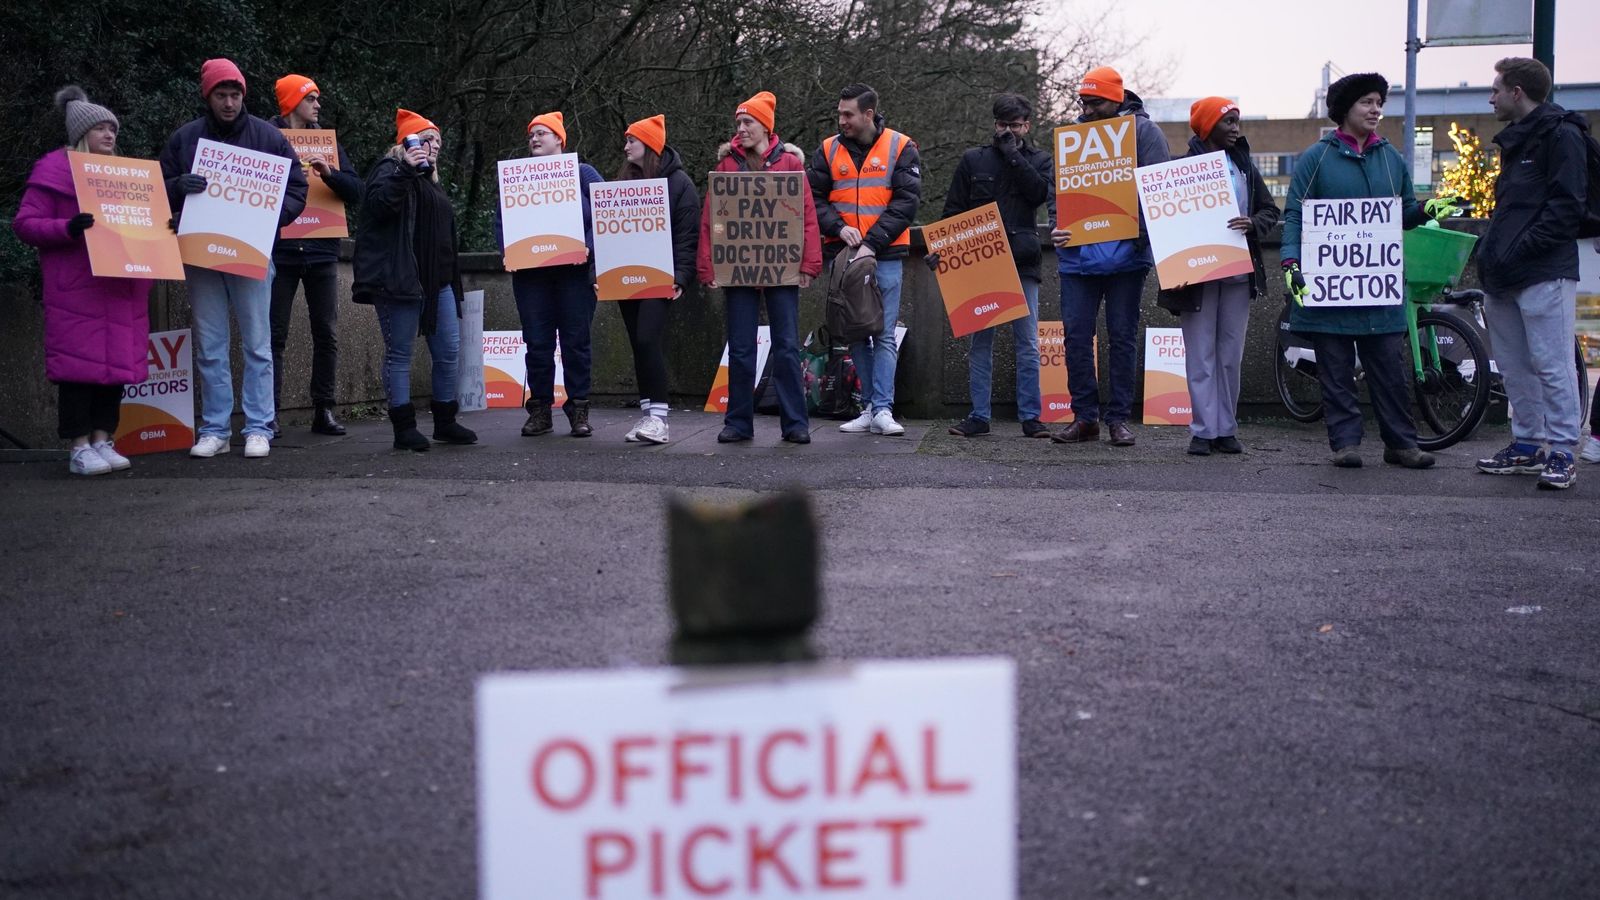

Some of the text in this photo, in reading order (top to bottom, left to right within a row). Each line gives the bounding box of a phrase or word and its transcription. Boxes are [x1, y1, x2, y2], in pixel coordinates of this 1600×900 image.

[286, 135, 332, 144] HOUR IS
[1058, 121, 1130, 166] PAY
[201, 147, 270, 171] £15/HOUR
[272, 163, 285, 174] IS
[503, 159, 574, 176] £15/HOUR IS
[1059, 156, 1132, 176] RESTORATION FOR
[83, 163, 150, 179] FIX OUR PAY
[198, 158, 282, 184] NOT A FAIR WAGE
[503, 175, 520, 184] NOT
[530, 172, 549, 181] FAIR
[551, 169, 574, 179] WAGE
[1059, 166, 1133, 191] DOCTORS
[1141, 158, 1223, 184] £15/HOUR IS
[87, 178, 154, 192] RETAIN OUR
[224, 175, 232, 185] A
[234, 176, 280, 195] JUNIOR
[504, 178, 576, 194] FOR A JUNIOR
[713, 176, 799, 196] CUTS TO
[1142, 170, 1225, 194] NOT A FAIR WAGE
[1145, 179, 1228, 204] FOR A JUNIOR
[96, 189, 150, 202] DOCTORS
[207, 182, 277, 211] OCTOR
[504, 188, 577, 208] DOCTOR
[594, 185, 664, 199] £15/HOUR IS
[101, 203, 151, 216] PROTECT
[594, 196, 664, 208] NOT A FAIR WAGE
[738, 198, 778, 218] PAY
[1147, 190, 1232, 221] DOCTOR
[103, 214, 153, 227] THE NHS
[302, 216, 320, 224] BMA
[595, 206, 665, 219] FOR A JUNIOR
[1313, 199, 1393, 226] FAIR PAY
[596, 217, 666, 235] DOCTOR
[726, 221, 788, 240] DRIVE
[928, 210, 996, 241] £15/HOUR IS
[1092, 219, 1110, 229] BMA
[930, 221, 999, 250] NOT A FAIR WAGE
[956, 244, 964, 253] A
[964, 230, 1002, 251] JUNIOR
[1327, 230, 1373, 241] for the
[217, 246, 237, 257] BMA
[540, 243, 558, 252] BMA
[713, 244, 800, 264] DOCTORS
[1318, 243, 1400, 268] PUBLIC
[937, 241, 1006, 275] DOCTOR
[1197, 255, 1218, 265] BMA
[630, 275, 647, 284] BMA
[730, 265, 786, 285] AWAY
[1311, 274, 1400, 302] SECTOR
[981, 301, 999, 313] BMA
[483, 345, 520, 354] PICKET
[1152, 335, 1183, 345] OFFI
[147, 334, 186, 370] AY
[172, 369, 188, 378] FOR
[149, 429, 166, 439] BMA
[530, 723, 973, 813] OFFICIAL
[585, 817, 925, 900] PICKET
